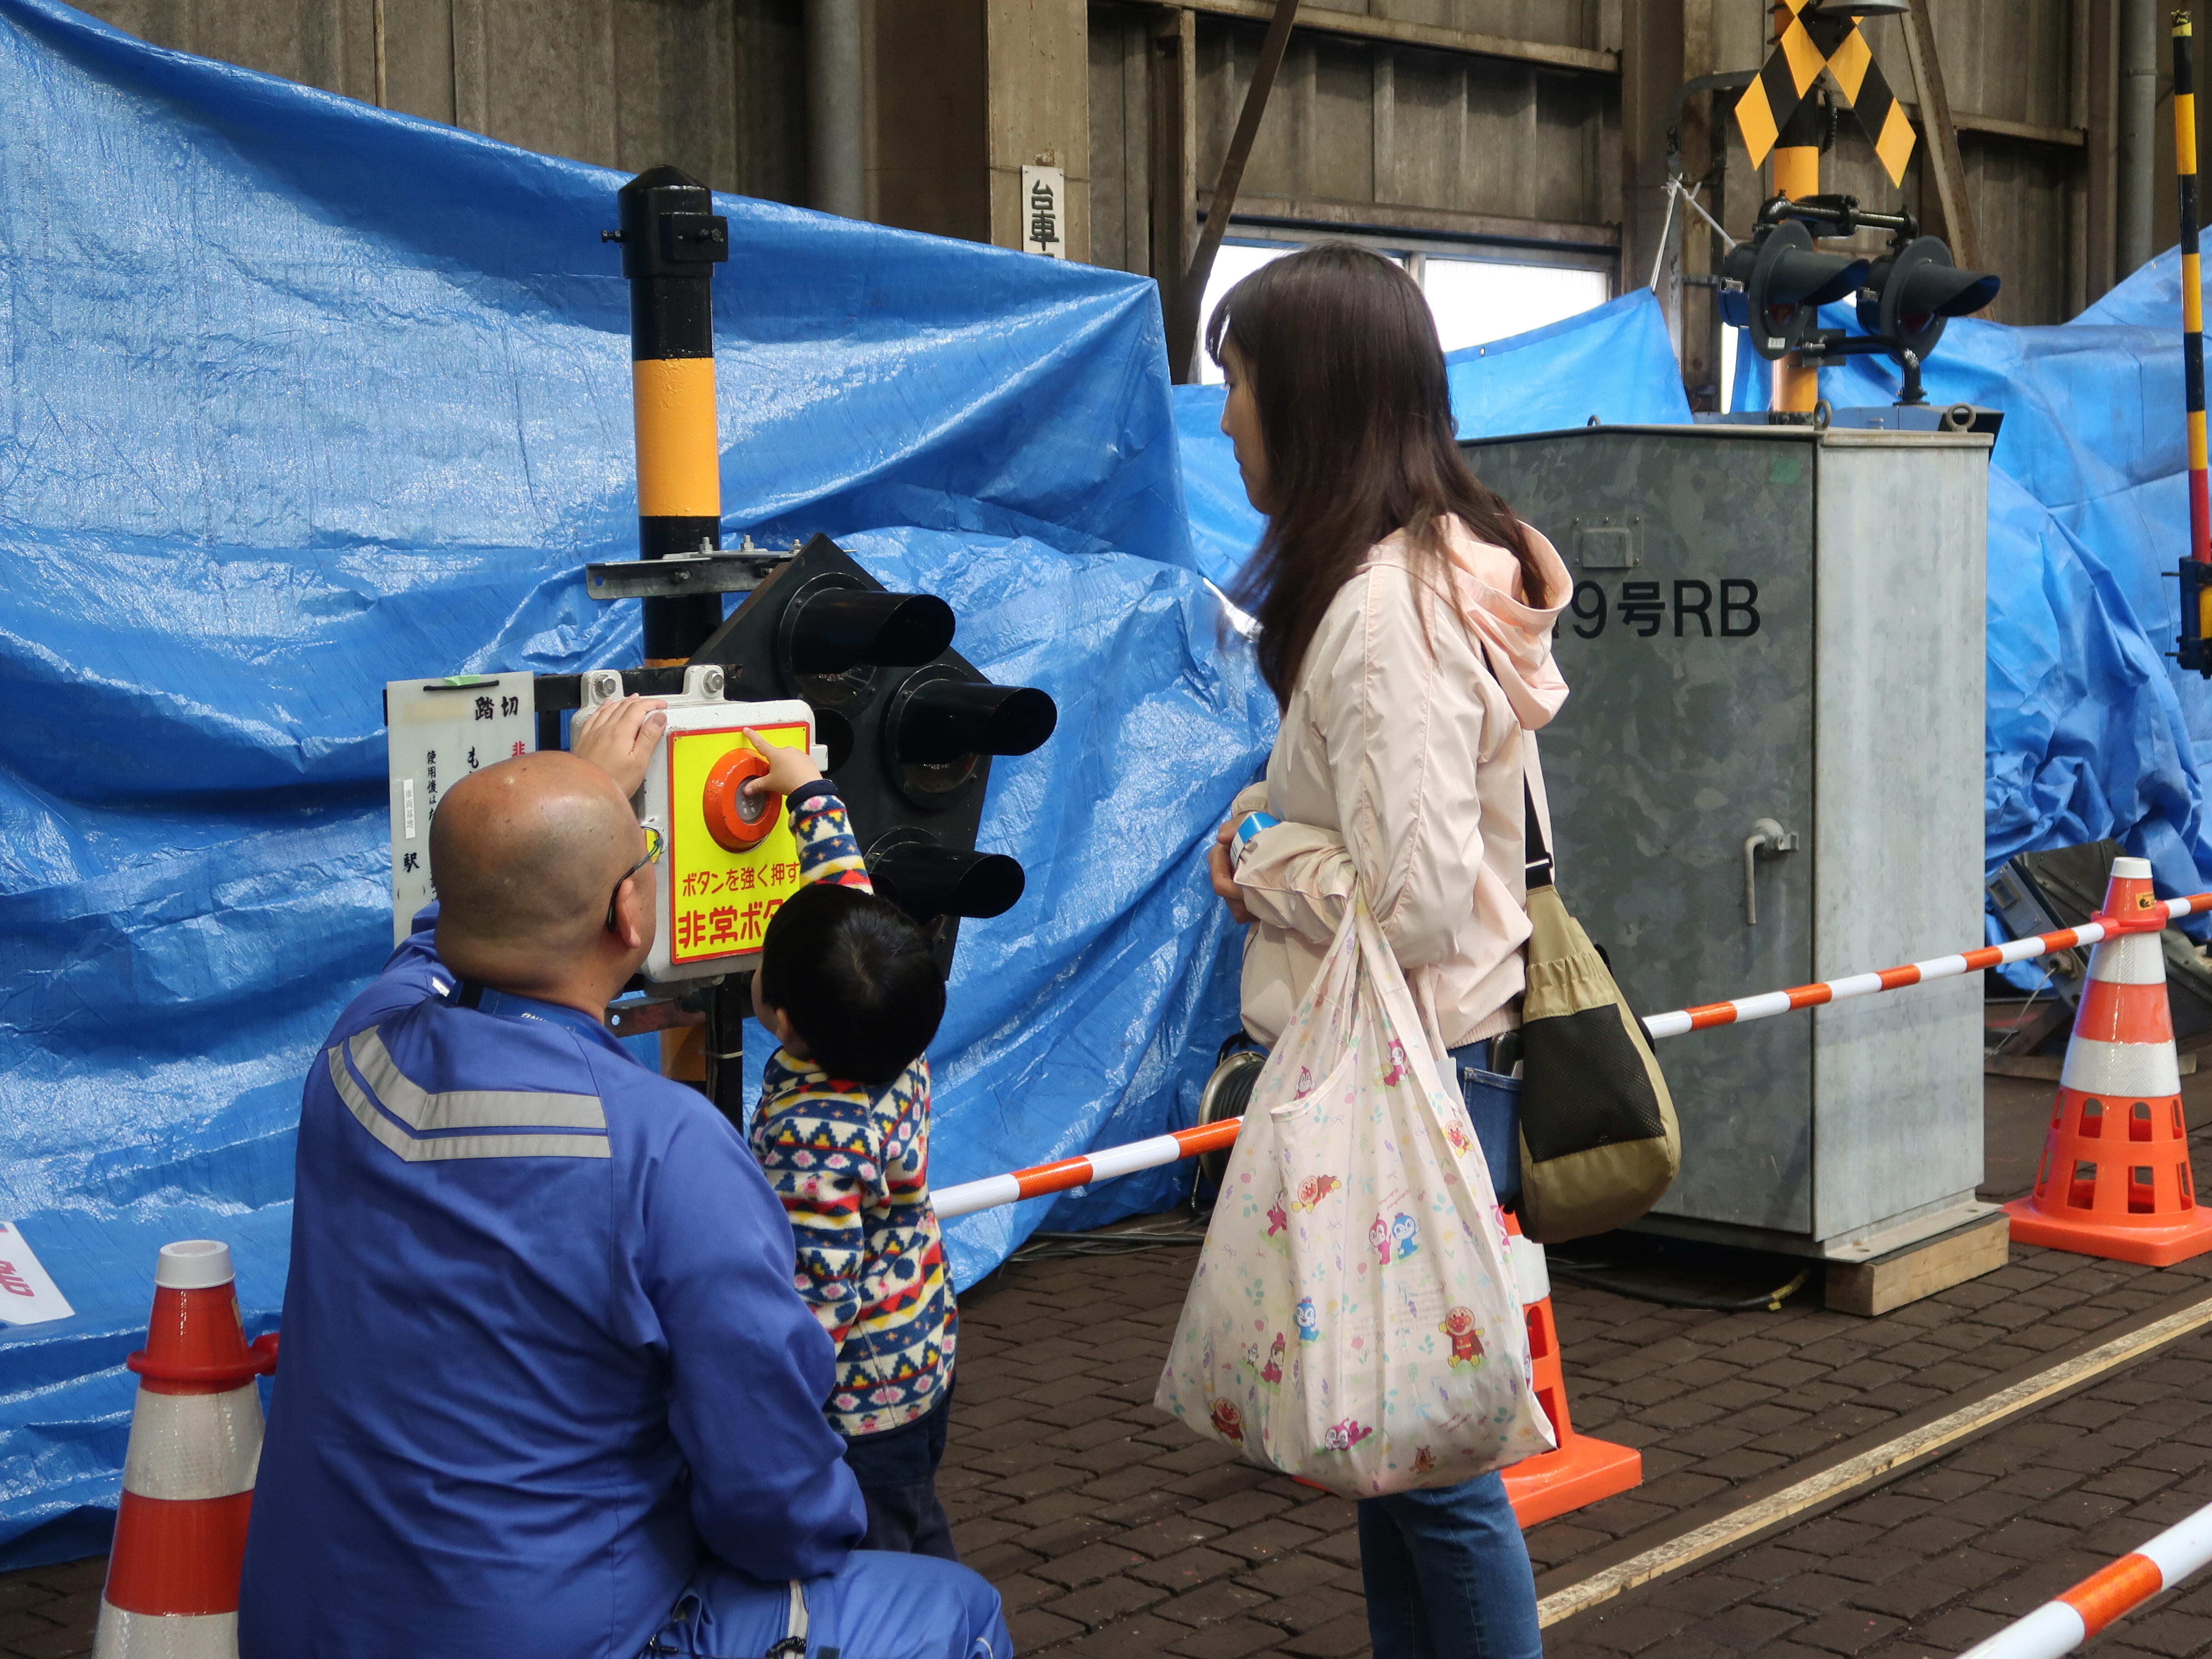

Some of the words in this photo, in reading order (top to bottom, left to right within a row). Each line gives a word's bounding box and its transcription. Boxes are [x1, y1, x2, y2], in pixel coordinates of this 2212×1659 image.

[1029, 179, 1060, 257] 台車
[1552, 578, 1761, 639] 9号RB
[467, 745, 479, 774] も
[402, 852, 420, 873] 駅
[682, 861, 800, 897] ボタンを強く押す
